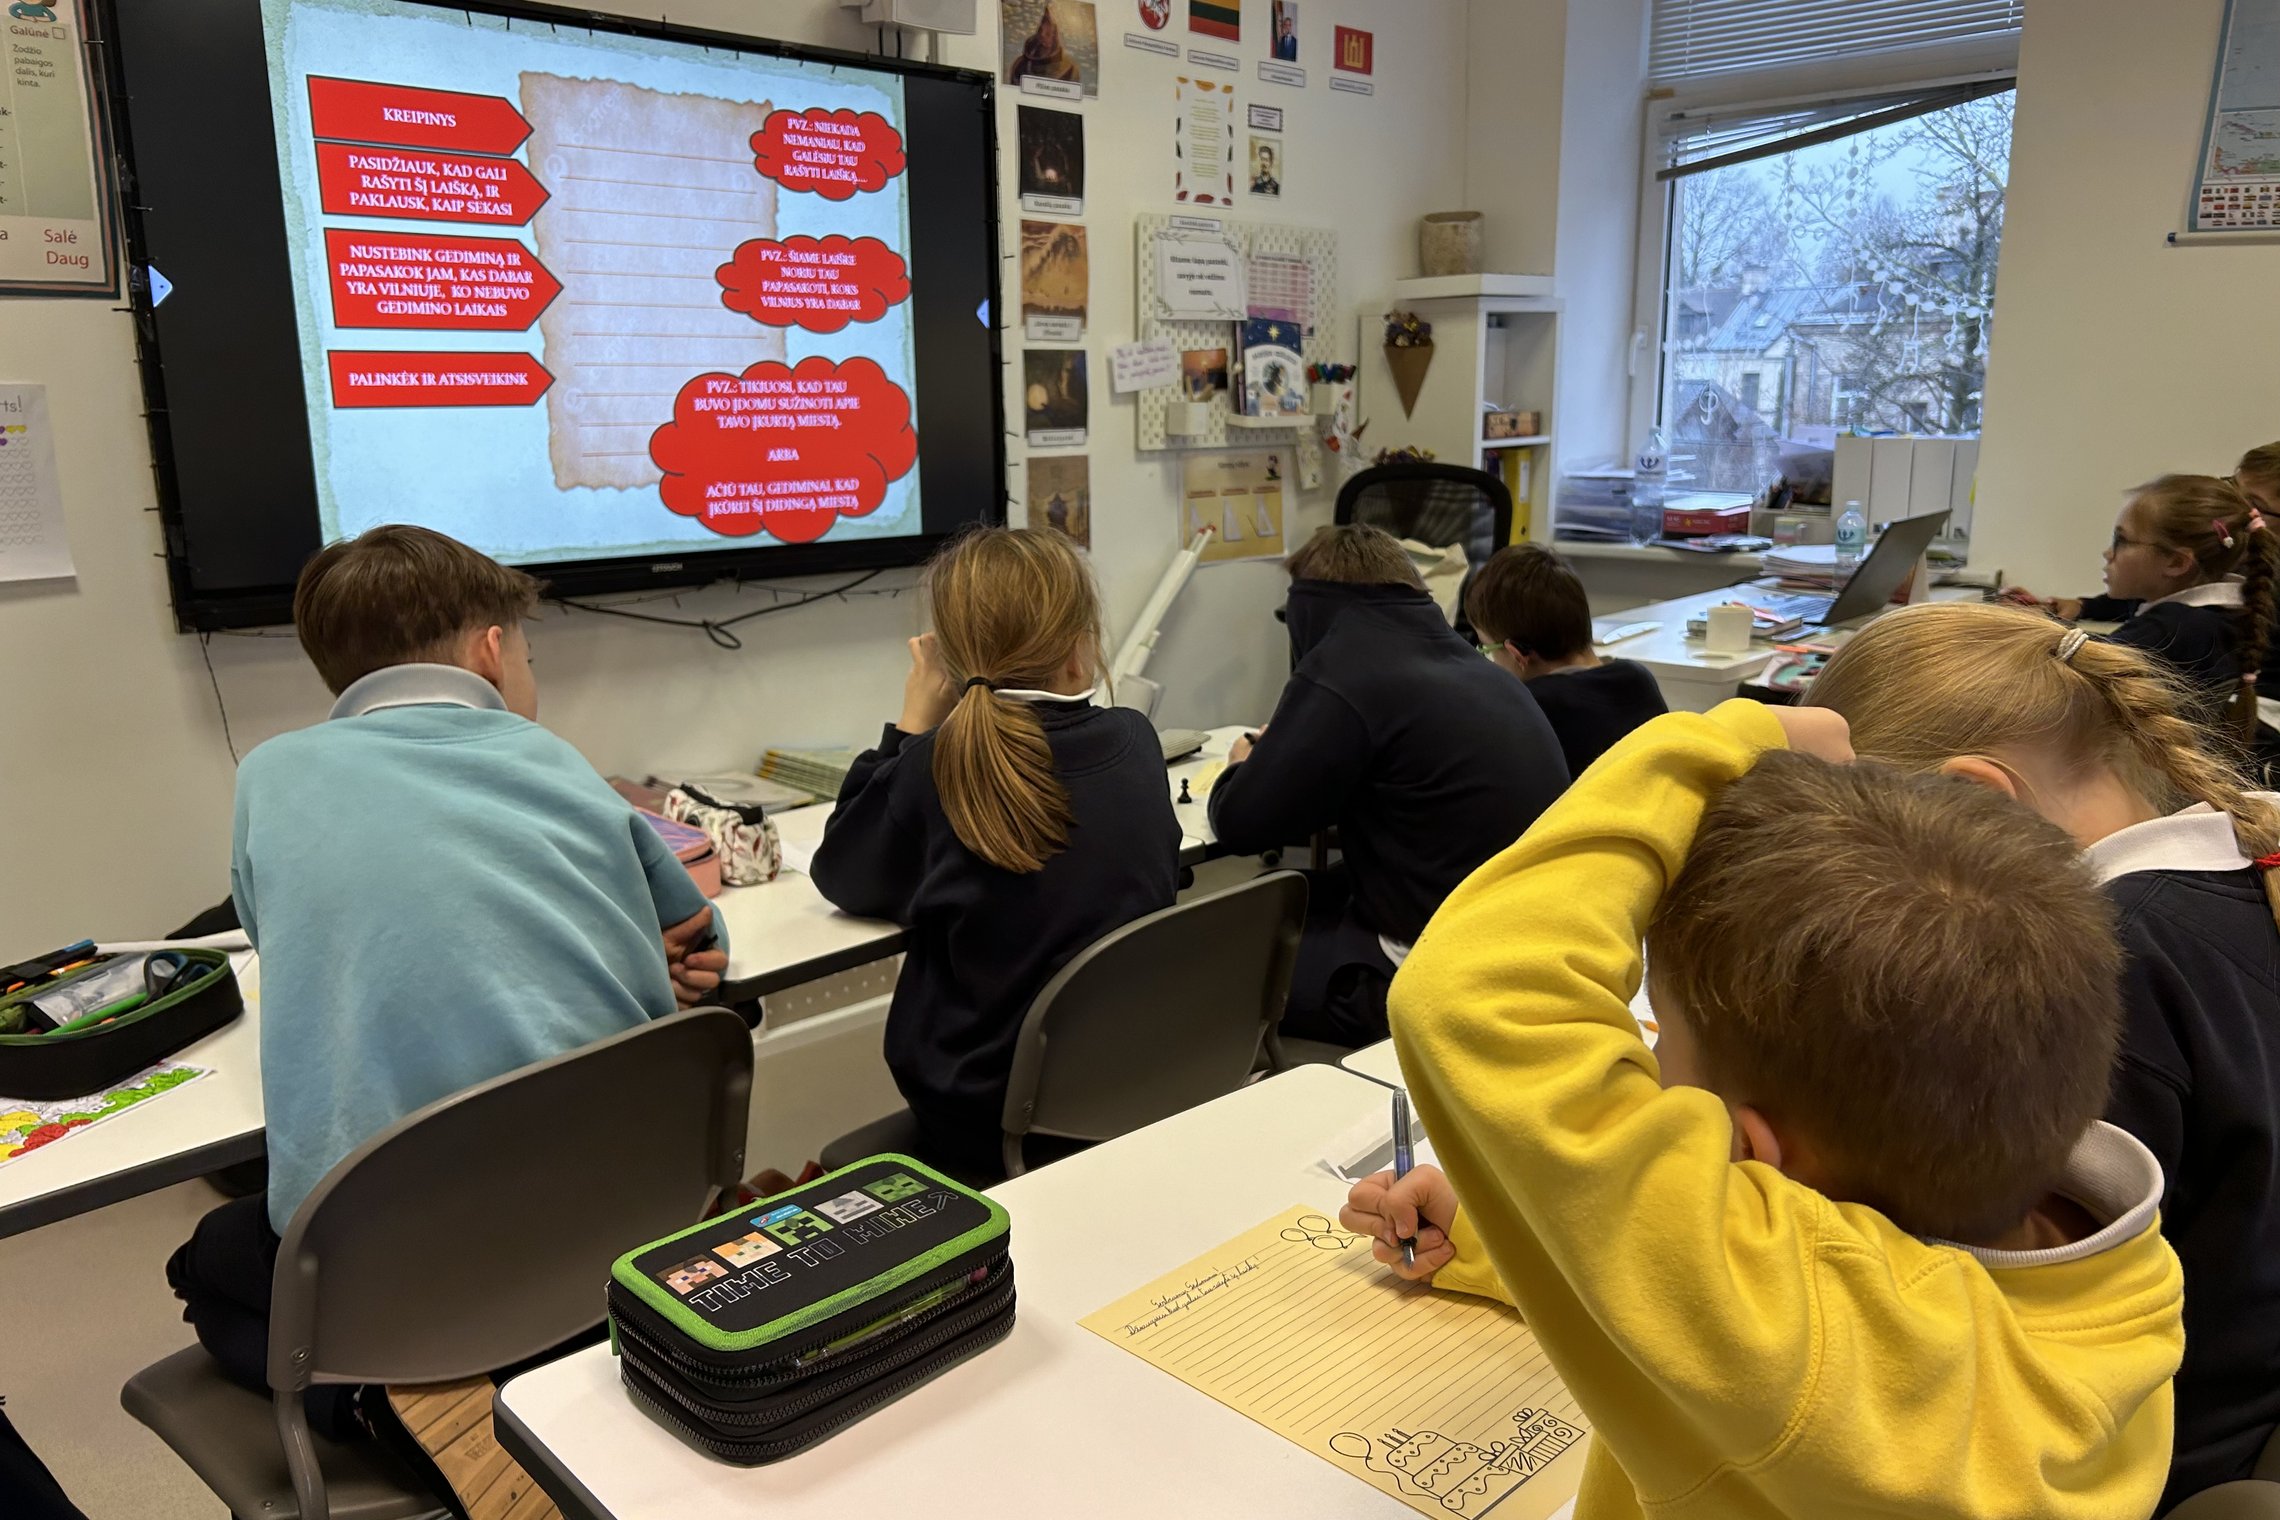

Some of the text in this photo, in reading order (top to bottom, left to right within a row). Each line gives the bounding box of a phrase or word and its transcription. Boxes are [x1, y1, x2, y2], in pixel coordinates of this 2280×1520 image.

[14, 57, 53, 68] pabaigos
[38, 69, 56, 78] kuri
[383, 107, 456, 128] KREIPINYS
[814, 121, 861, 137] NIEKADA
[843, 140, 866, 153] KAD
[348, 155, 508, 181] PASIDŽIAUK, KAD GALI
[837, 153, 859, 167] TAU
[783, 164, 821, 178] RAŠYTI
[361, 174, 500, 200] RAŠYTI ŠĮ LAIŠKĄ, IR
[349, 192, 513, 216] PAKLAUSK, KAIP SEKASI
[44, 228, 78, 244] Salė
[46, 250, 89, 270] Daug
[349, 245, 521, 268] NUSTEBINK GEDIMINĄ IR
[788, 249, 821, 264] ŠIAME
[822, 253, 858, 266] LAIŠKE
[339, 263, 534, 284] PAPASAKOK JAM, KAS DABAR
[781, 266, 840, 280] NORIU TAU
[346, 281, 530, 300] YRA VILNIUJE, KO NEBUVO
[830, 283, 859, 295] KOKS
[377, 300, 508, 317] GEDIMINO LAIKAIS
[760, 296, 861, 311] VILNIUS YRA DABAR
[348, 370, 529, 386] PALINKĖK IR ATSISVEIKINK
[797, 380, 823, 394] KAD
[823, 380, 848, 394] TAU
[694, 395, 861, 414] BUVO ĮDOMU SUŽINOTI APIE
[716, 415, 751, 429] TAVO
[767, 447, 800, 462] ARBA
[738, 482, 766, 497] TAU,
[834, 478, 860, 491] KAD
[689, 1199, 937, 1313] TIME TO MINE
